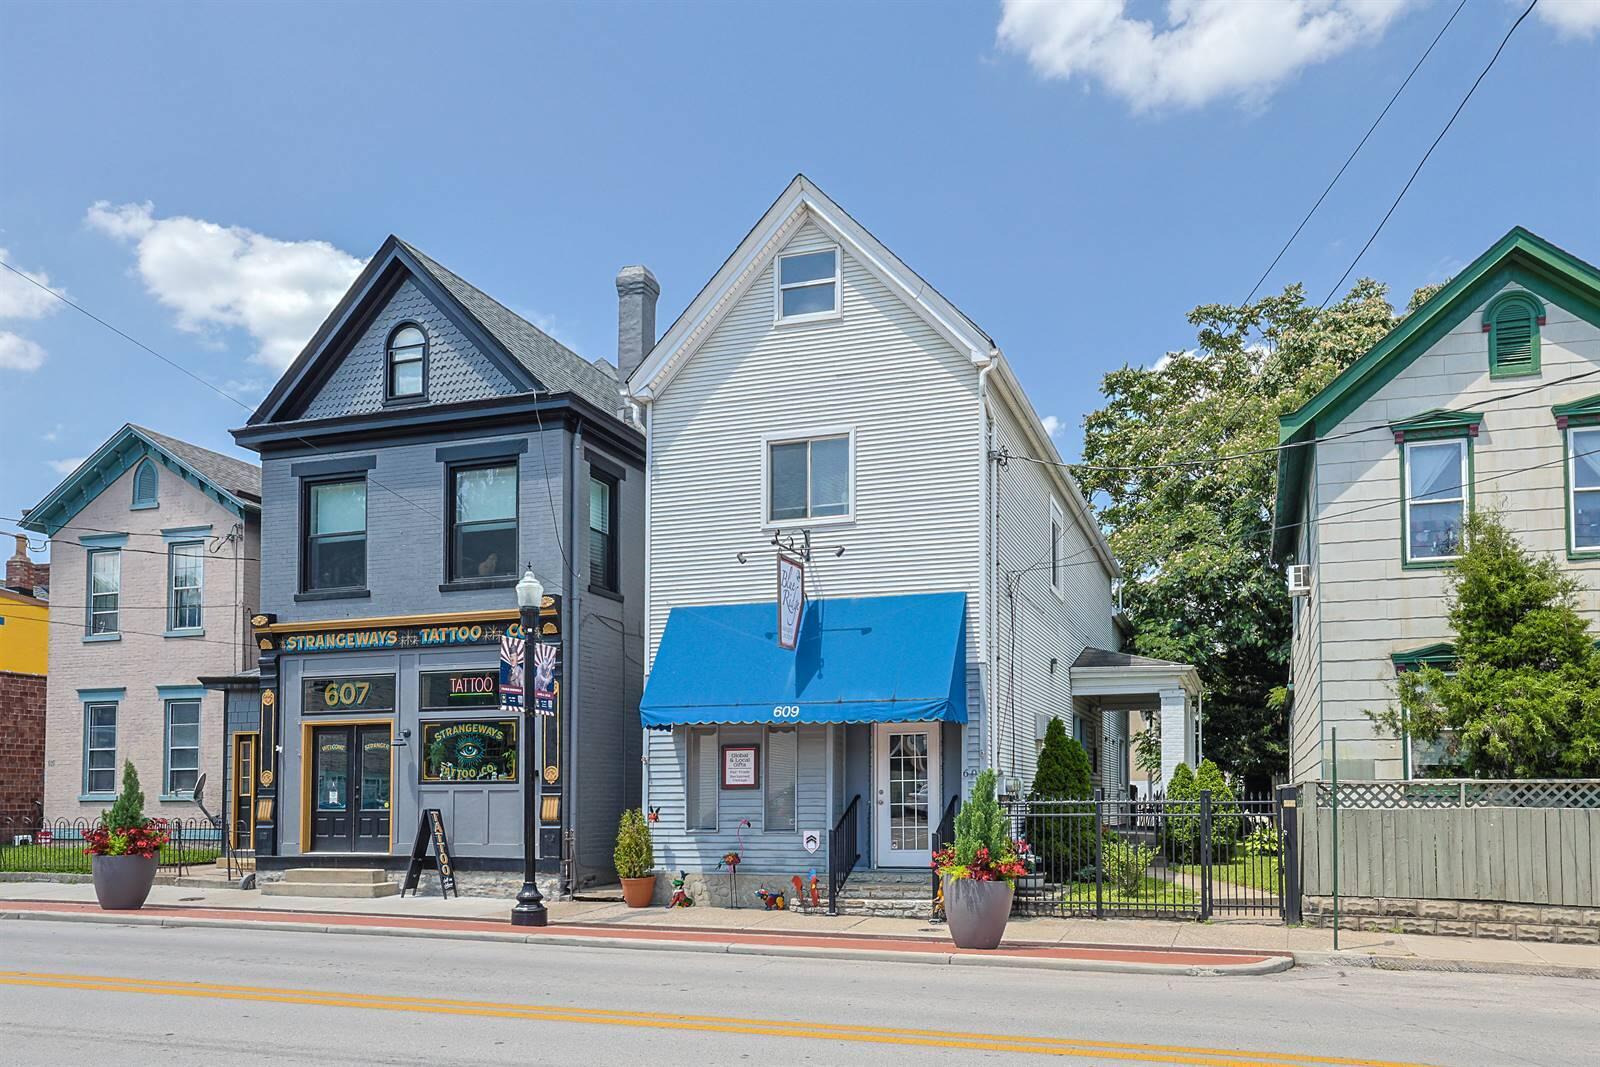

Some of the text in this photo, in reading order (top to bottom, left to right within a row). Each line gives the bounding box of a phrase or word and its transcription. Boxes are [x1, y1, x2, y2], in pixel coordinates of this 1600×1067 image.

[286, 630, 398, 650] STRANGEWAYS
[420, 625, 482, 644] TATTOO
[324, 681, 371, 707] 607
[450, 676, 493, 693] TATTOO
[773, 705, 800, 718] 609
[434, 723, 504, 741] STRANGEWAYS
[430, 811, 450, 876] TATTOO
